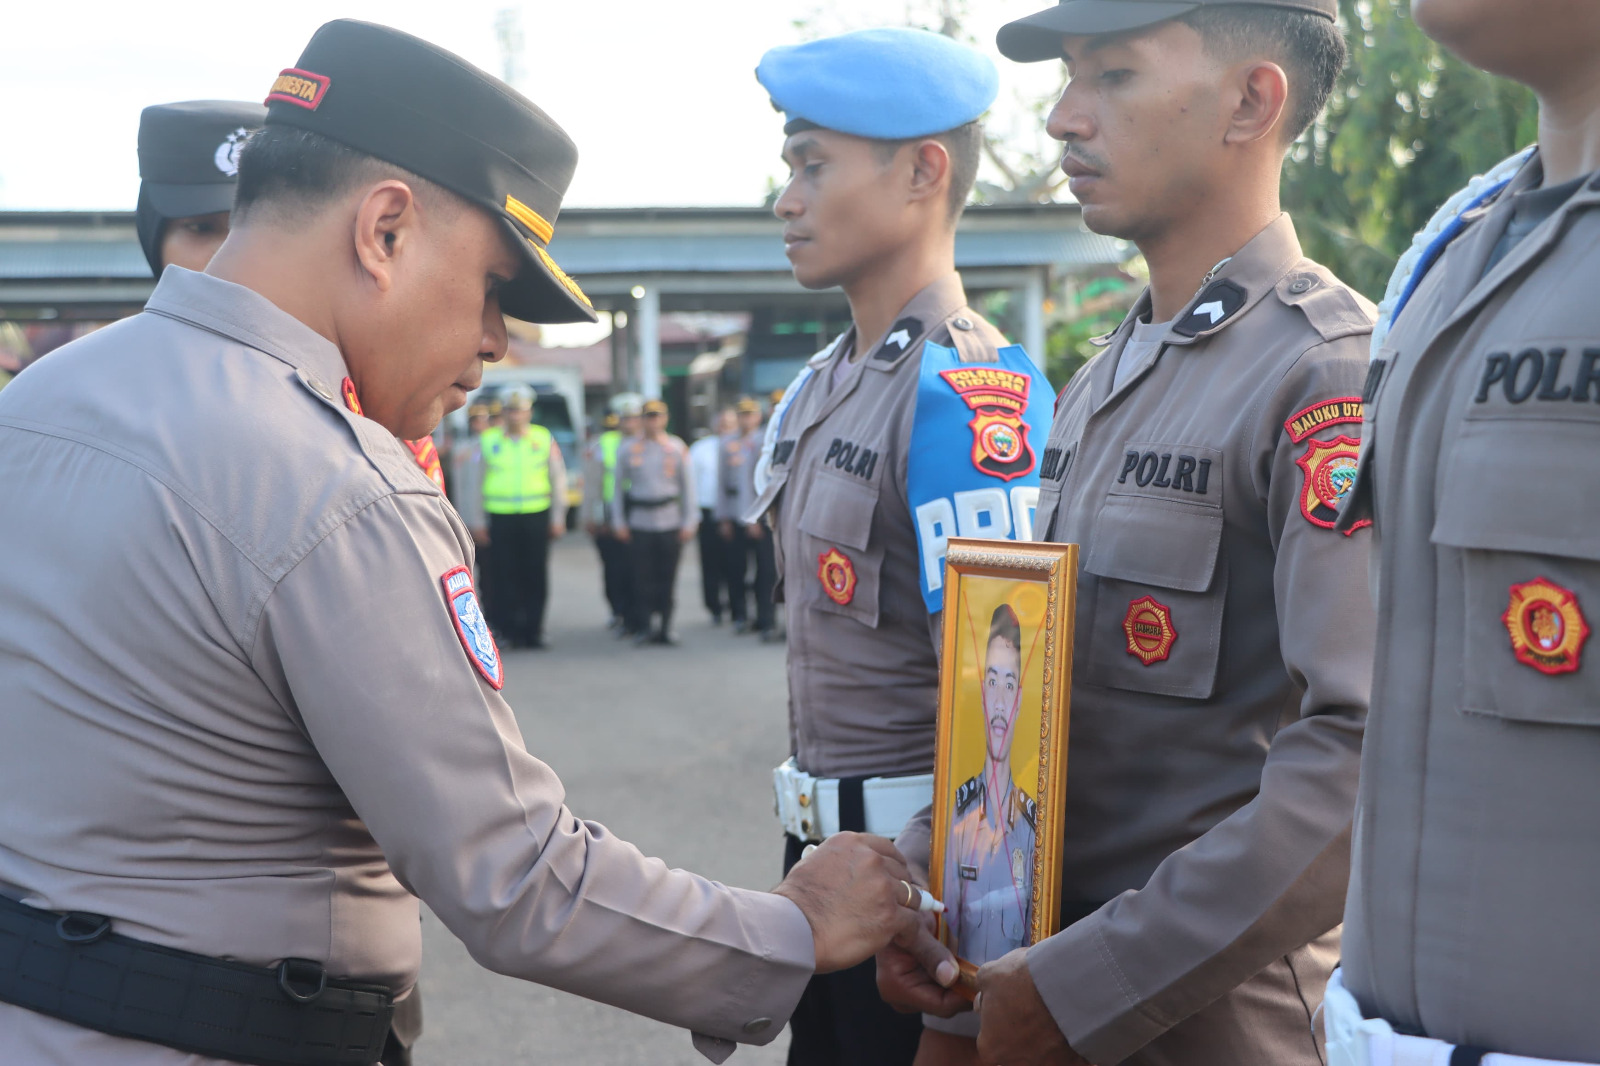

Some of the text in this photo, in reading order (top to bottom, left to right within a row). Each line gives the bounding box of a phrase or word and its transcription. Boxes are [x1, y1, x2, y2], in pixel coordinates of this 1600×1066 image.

[948, 369, 1025, 385] POLRESTA
[957, 378, 1024, 392] TIDORE
[1292, 405, 1339, 437] MALUKU
[825, 438, 878, 480] POLRI
[1117, 451, 1211, 494] POLRI
